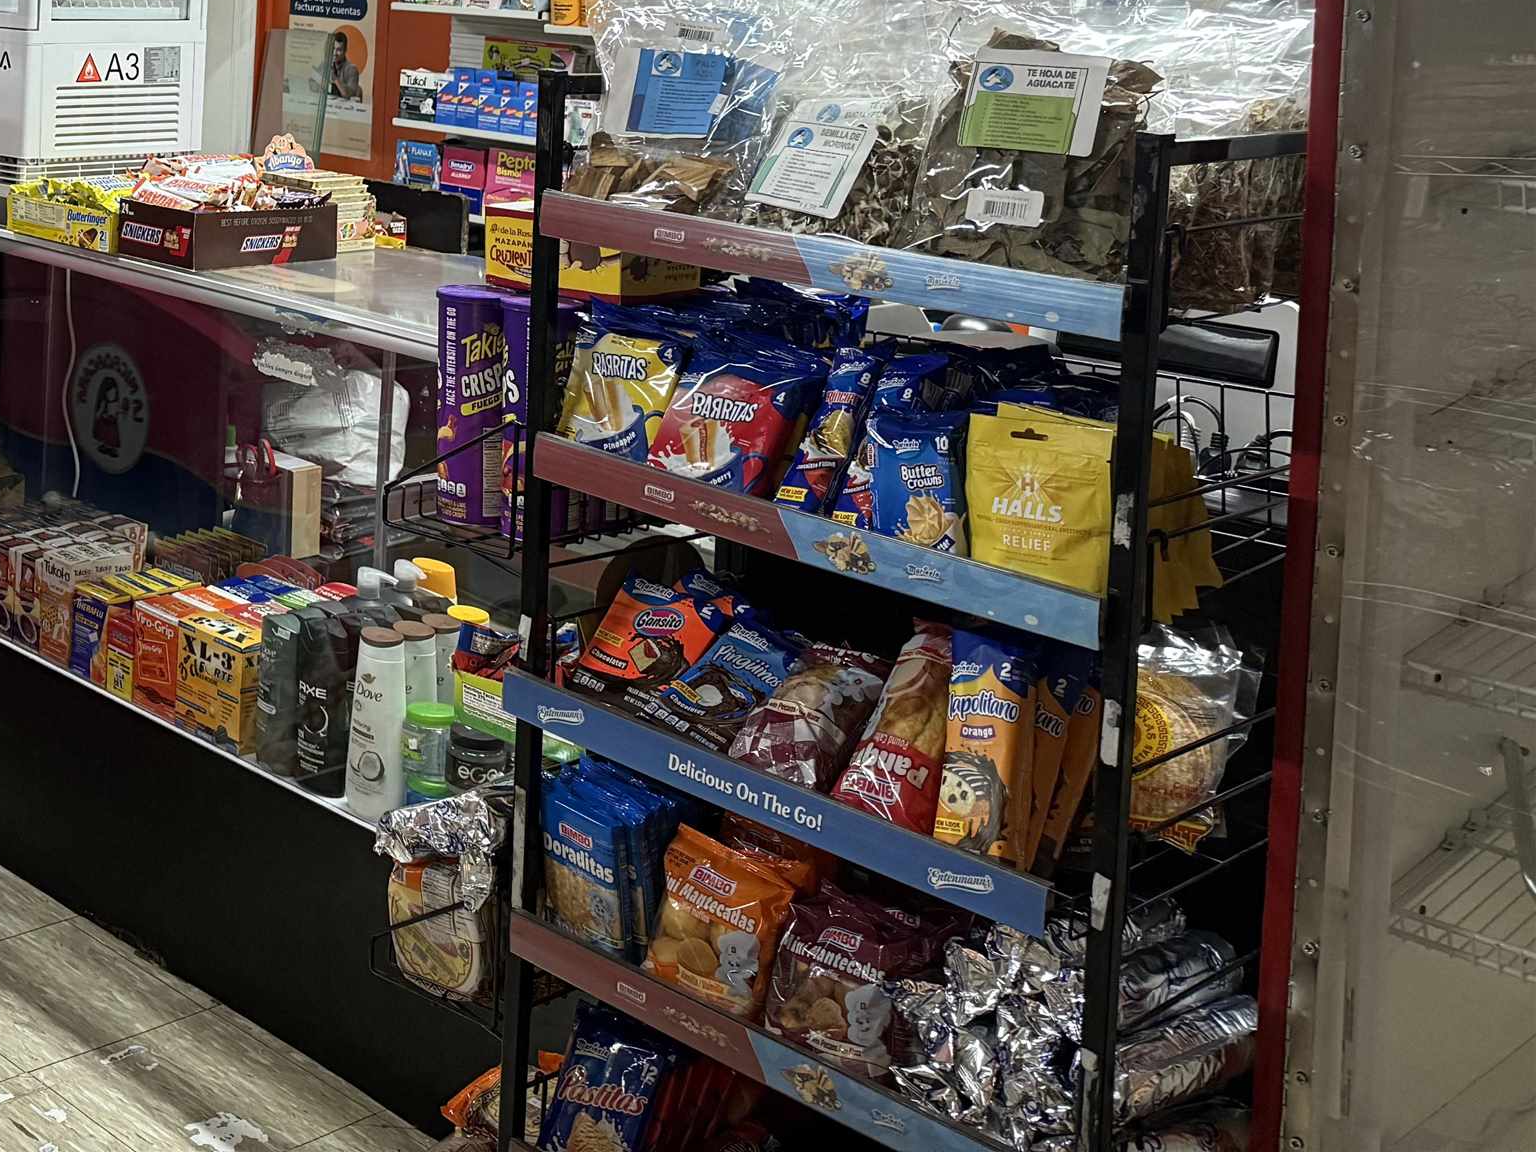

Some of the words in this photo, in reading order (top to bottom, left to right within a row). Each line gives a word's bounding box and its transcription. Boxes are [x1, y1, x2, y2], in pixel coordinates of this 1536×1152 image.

[295, 2, 324, 14] facturas
[332, 6, 361, 17] cuentas
[105, 53, 140, 81] A3
[1027, 69, 1038, 77] TE
[1039, 69, 1063, 79] HOJA
[1065, 71, 1077, 80] DE
[406, 74, 427, 86] Tukol
[1026, 79, 1076, 90] AGUACATE
[496, 166, 522, 178] Bismol
[67, 209, 108, 225] Butterfinger
[123, 222, 163, 244] SNICKERS
[244, 235, 282, 251] SNICKERS
[446, 338, 456, 368] INTENSITY
[461, 333, 506, 368] Takis
[664, 348, 673, 360] 4
[592, 352, 647, 380] BARRITAS
[447, 370, 456, 384] THE
[461, 367, 503, 397] CRISP
[861, 372, 872, 385] 8
[446, 386, 456, 406] FACE
[471, 395, 500, 411] FUEGO
[776, 391, 786, 404] 4
[903, 387, 913, 399] 8
[692, 392, 758, 422] BARRITAS
[603, 431, 637, 451] Pineapple
[935, 435, 950, 451] 10
[901, 465, 937, 480] Butter
[646, 487, 672, 501] BIMBO
[992, 497, 1063, 522] HALLS
[1003, 535, 1052, 551] RELIEF
[77, 599, 105, 619] THERAFLU
[135, 609, 176, 640] Viro-Grip
[637, 611, 683, 631] Gansito
[183, 633, 236, 670] XL-3
[714, 644, 783, 688] Pingüinos
[1000, 662, 1012, 679] 2
[299, 680, 327, 700] AXE
[356, 680, 383, 702] Dove
[961, 725, 993, 738] Orange
[668, 752, 733, 795] Delicious
[735, 780, 760, 807] On
[761, 791, 791, 820] The
[793, 806, 823, 833] Go!
[560, 823, 592, 848] BIMBO
[692, 867, 735, 897] BIMBO
[929, 868, 994, 892] Entenmann's
[681, 882, 756, 934] Mantecadas
[820, 927, 863, 950] BIMBO
[816, 947, 886, 982] Mantecadas
[618, 982, 645, 1002] BIMBO
[558, 1065, 649, 1116] Pastitas
